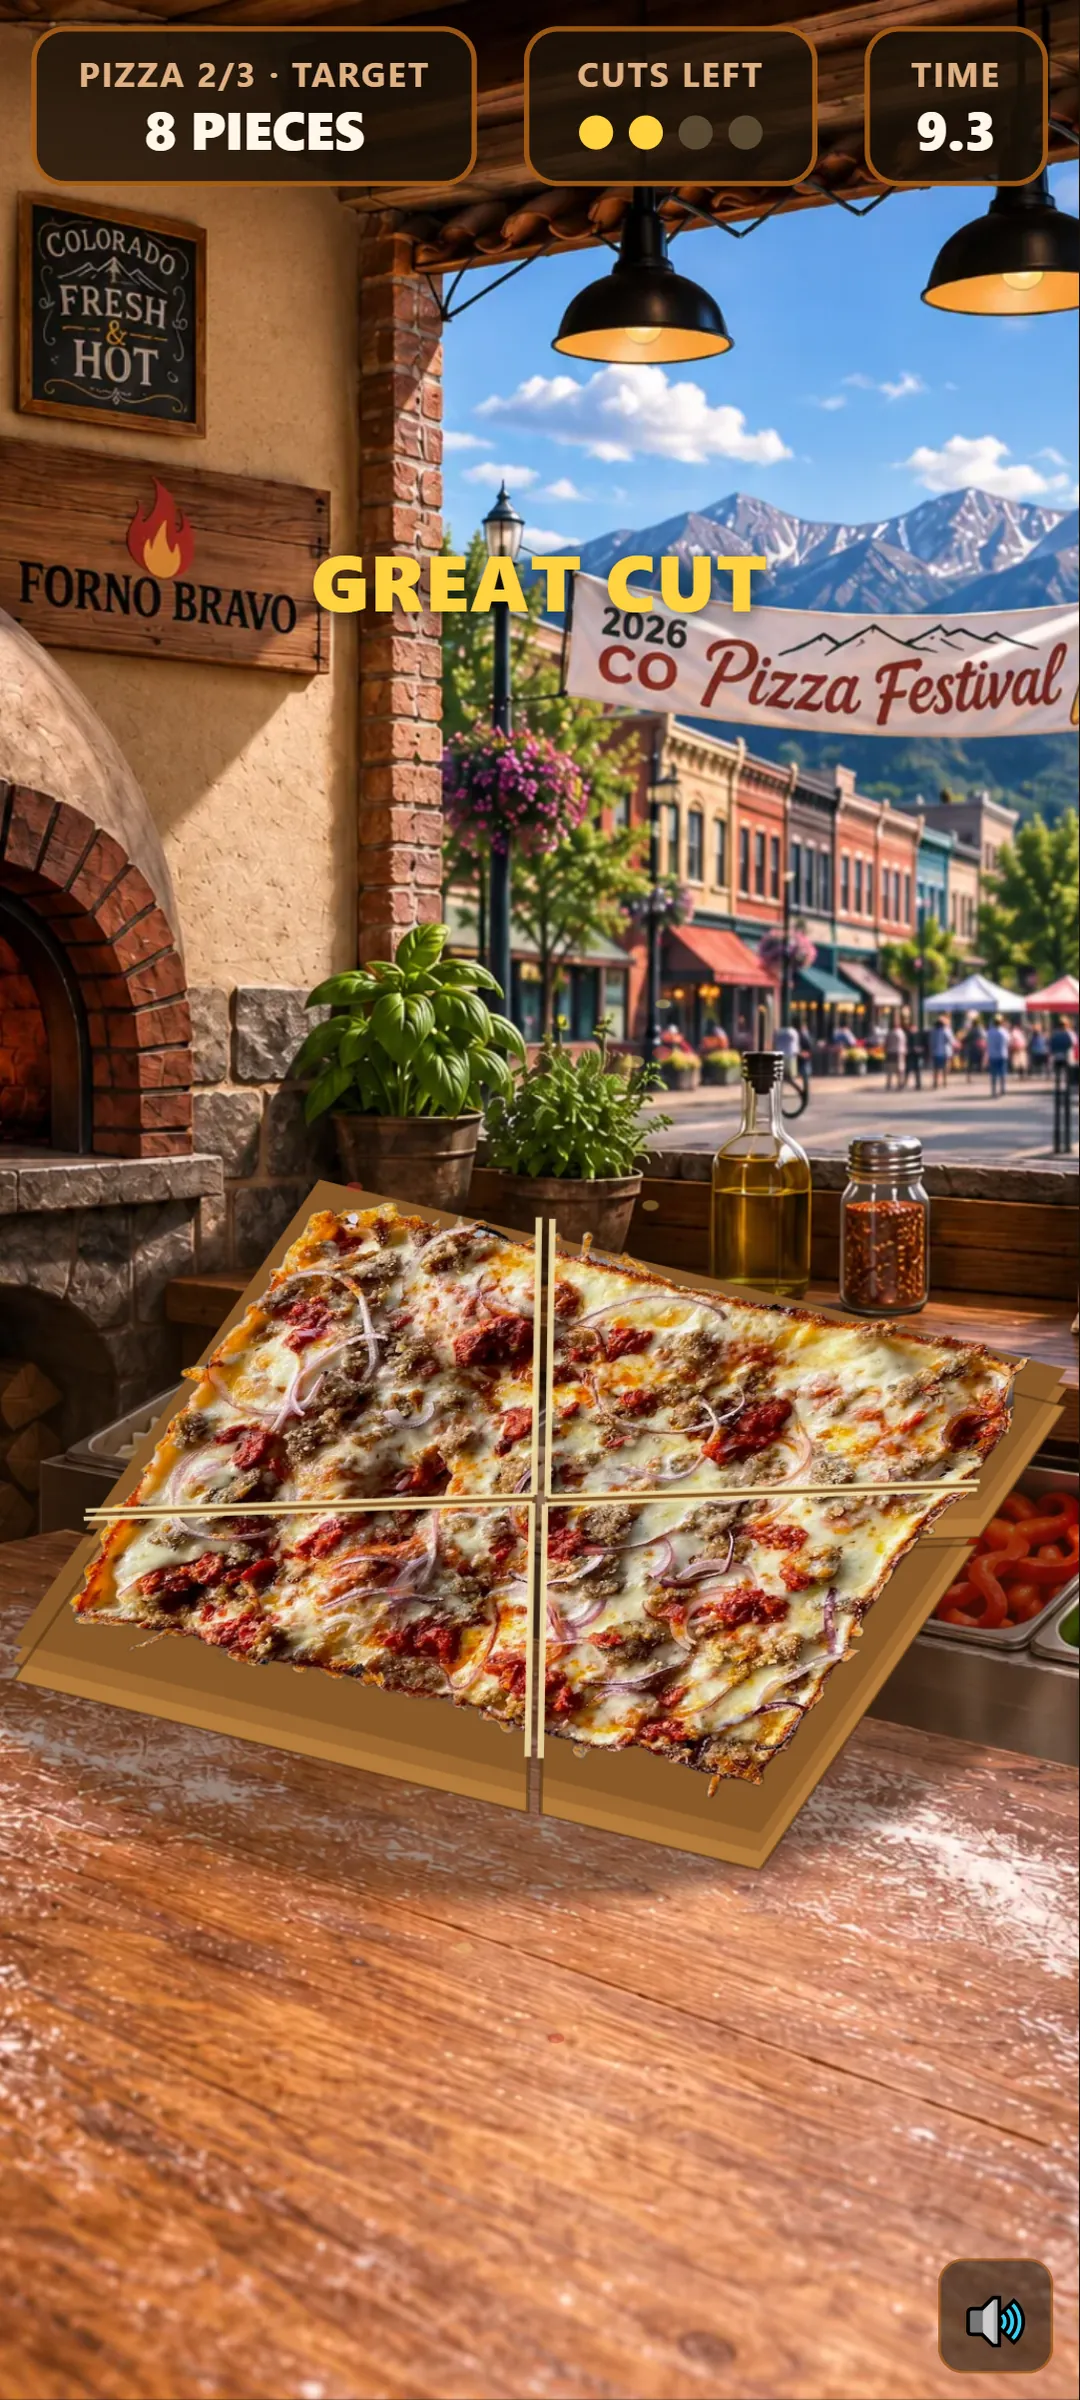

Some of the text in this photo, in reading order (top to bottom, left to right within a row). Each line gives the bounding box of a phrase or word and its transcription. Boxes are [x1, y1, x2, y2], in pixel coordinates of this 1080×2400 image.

[46, 228, 176, 275] COLORADO
[58, 284, 168, 330] FRESH
[106, 320, 127, 345] &
[73, 339, 159, 386] HOT
[18, 560, 297, 634] FORNO BRAVO
[602, 606, 688, 649] 2026
[598, 639, 1067, 726] CO Pizza Festival
